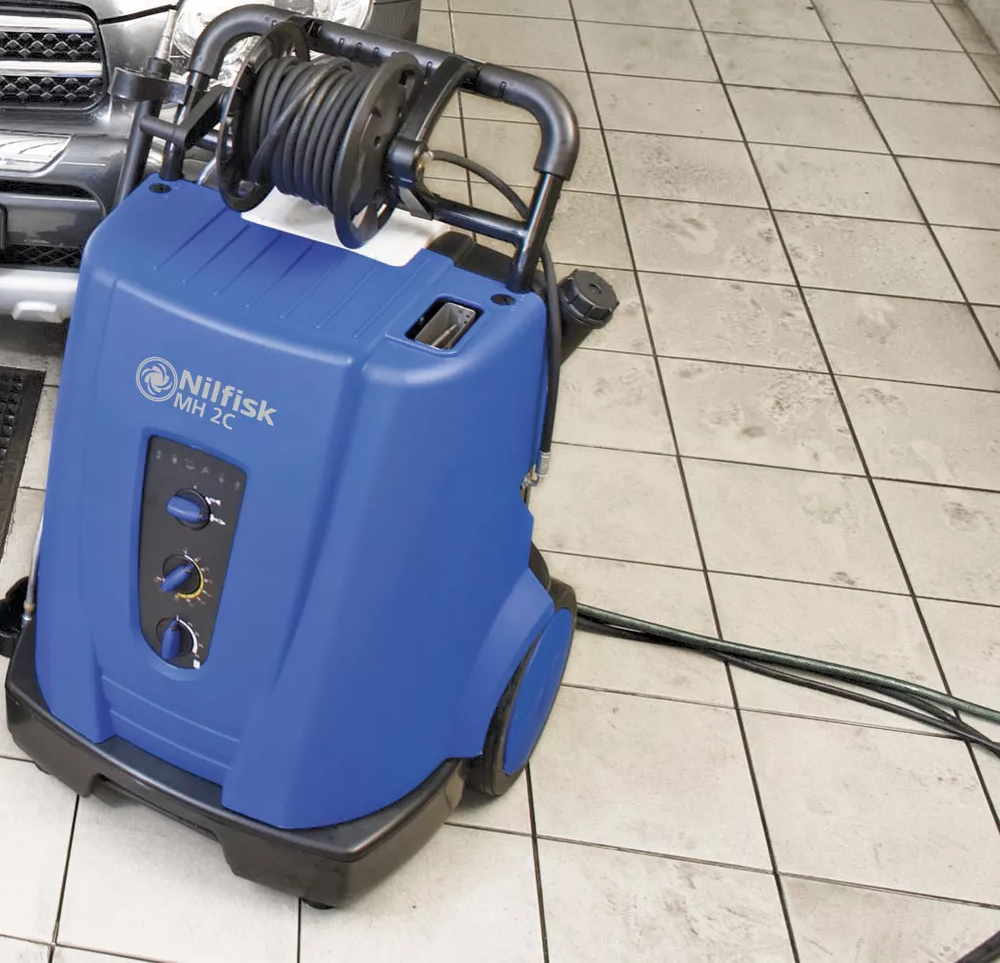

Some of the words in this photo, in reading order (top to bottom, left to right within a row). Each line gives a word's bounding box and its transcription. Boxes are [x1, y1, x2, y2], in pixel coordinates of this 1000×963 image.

[173, 392, 206, 418] MH
[210, 407, 236, 430] 2C
[178, 369, 278, 427] Nilfisk
